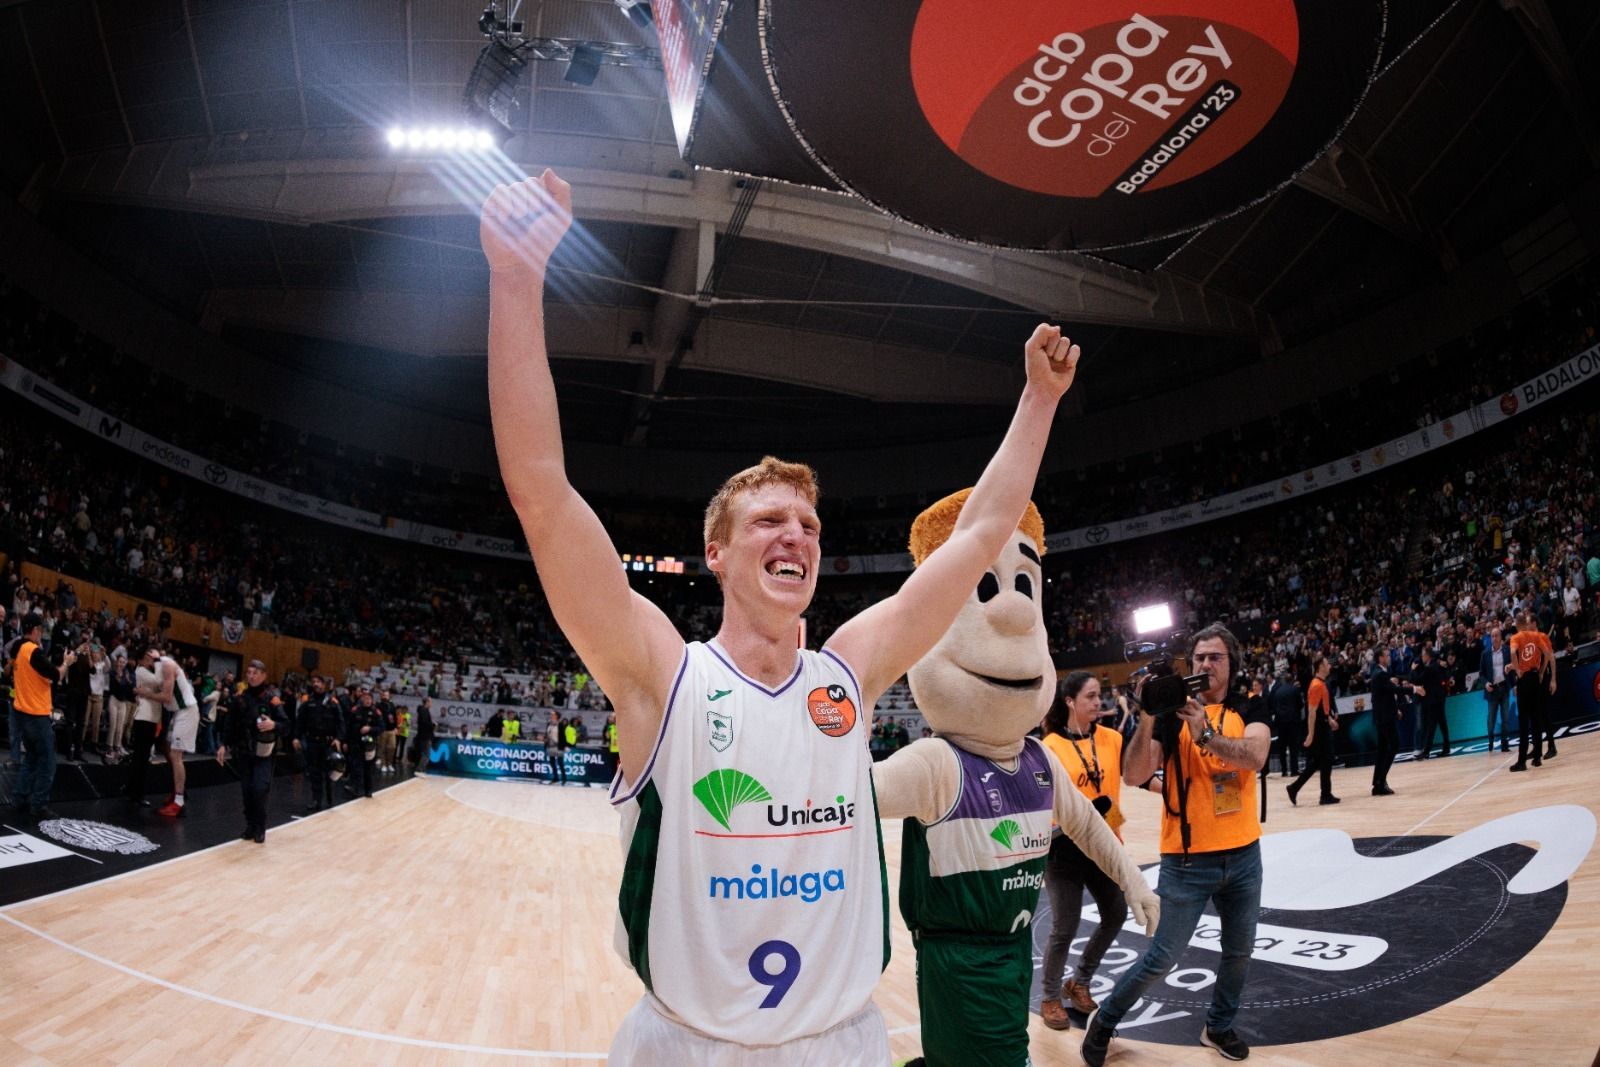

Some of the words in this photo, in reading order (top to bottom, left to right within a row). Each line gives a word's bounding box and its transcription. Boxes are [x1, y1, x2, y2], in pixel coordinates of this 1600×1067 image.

[1013, 32, 1086, 106] acb
[1028, 13, 1169, 147] Copa
[1087, 111, 1137, 157] del
[1129, 25, 1233, 120] Rey
[1116, 113, 1210, 194] Badalona
[142, 441, 190, 468] endesa
[447, 705, 481, 718] COPA
[518, 712, 534, 722] EY
[457, 744, 545, 761] PATROCINADOR
[477, 758, 509, 771] COPA
[511, 762, 532, 773] DEL
[748, 940, 802, 1009] 9
